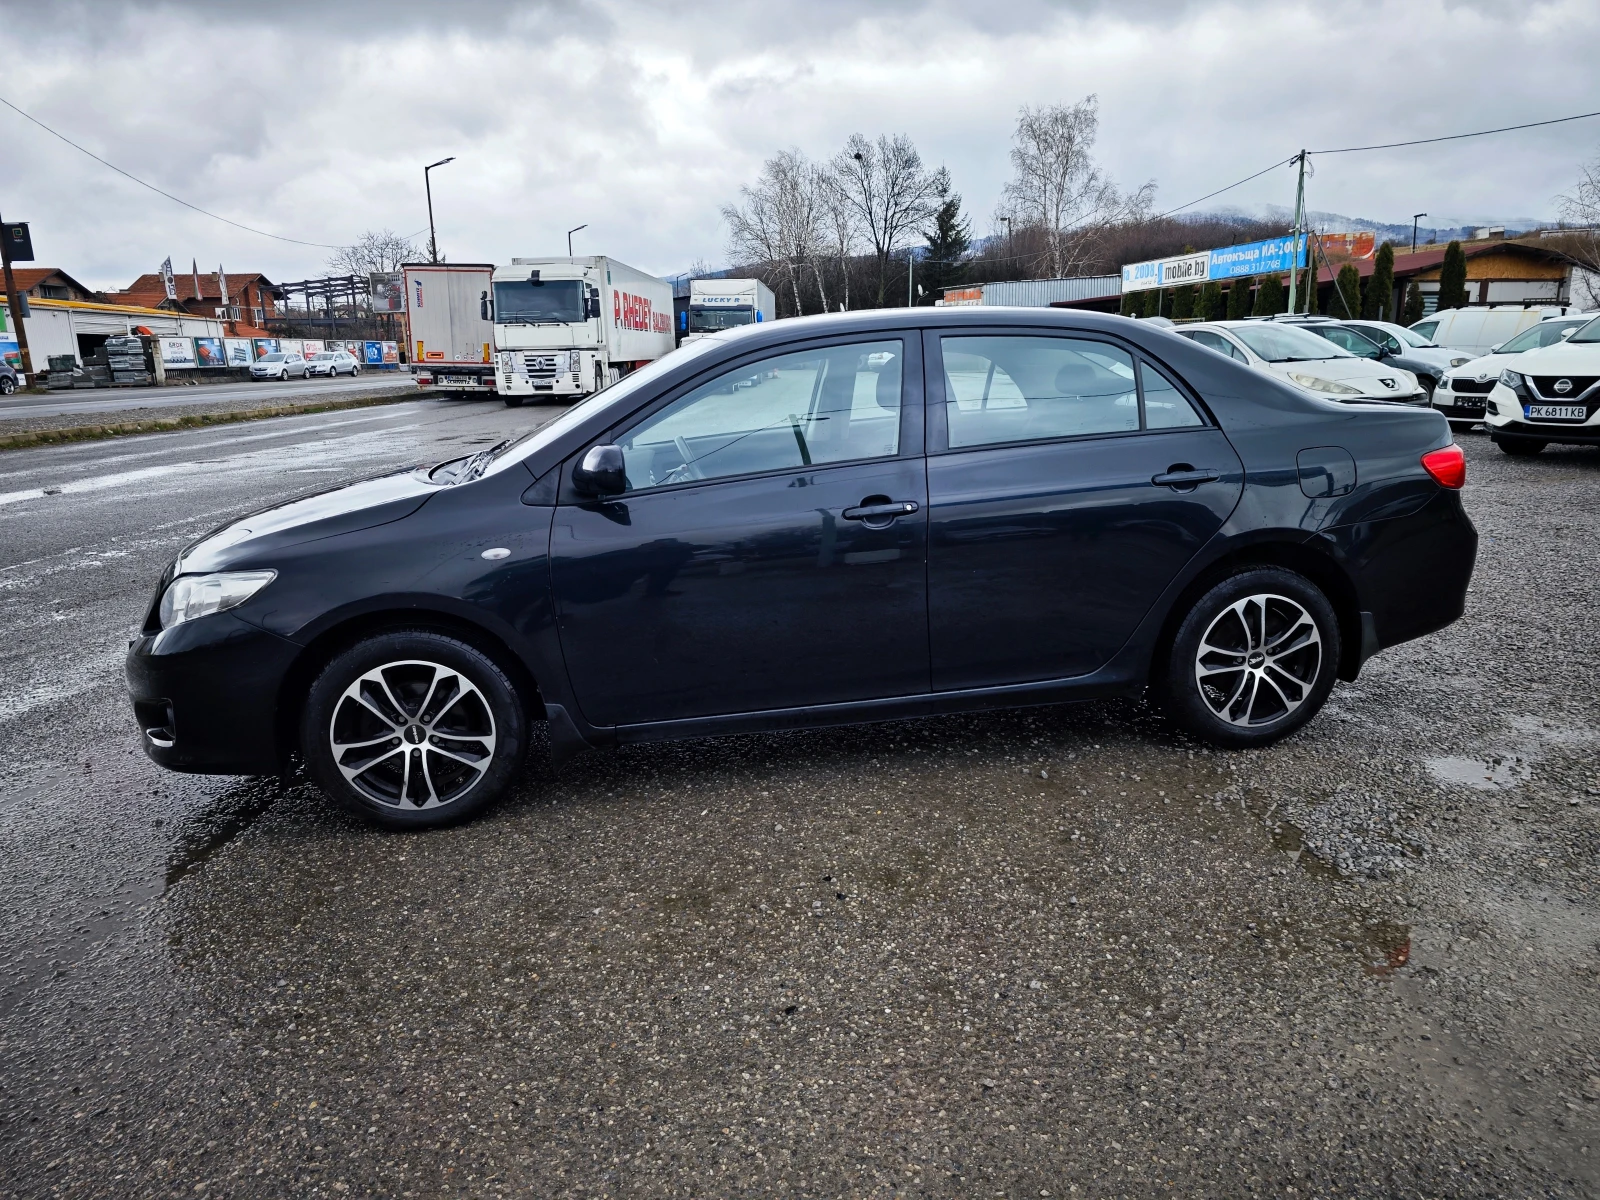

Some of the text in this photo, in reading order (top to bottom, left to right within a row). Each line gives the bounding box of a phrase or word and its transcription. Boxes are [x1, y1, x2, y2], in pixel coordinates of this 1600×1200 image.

[1211, 248, 1260, 265] Автокъща
[1165, 260, 1205, 280] mobile.bg
[1229, 264, 1250, 274] 0888
[1530, 406, 1585, 418] PK 6811 KB
